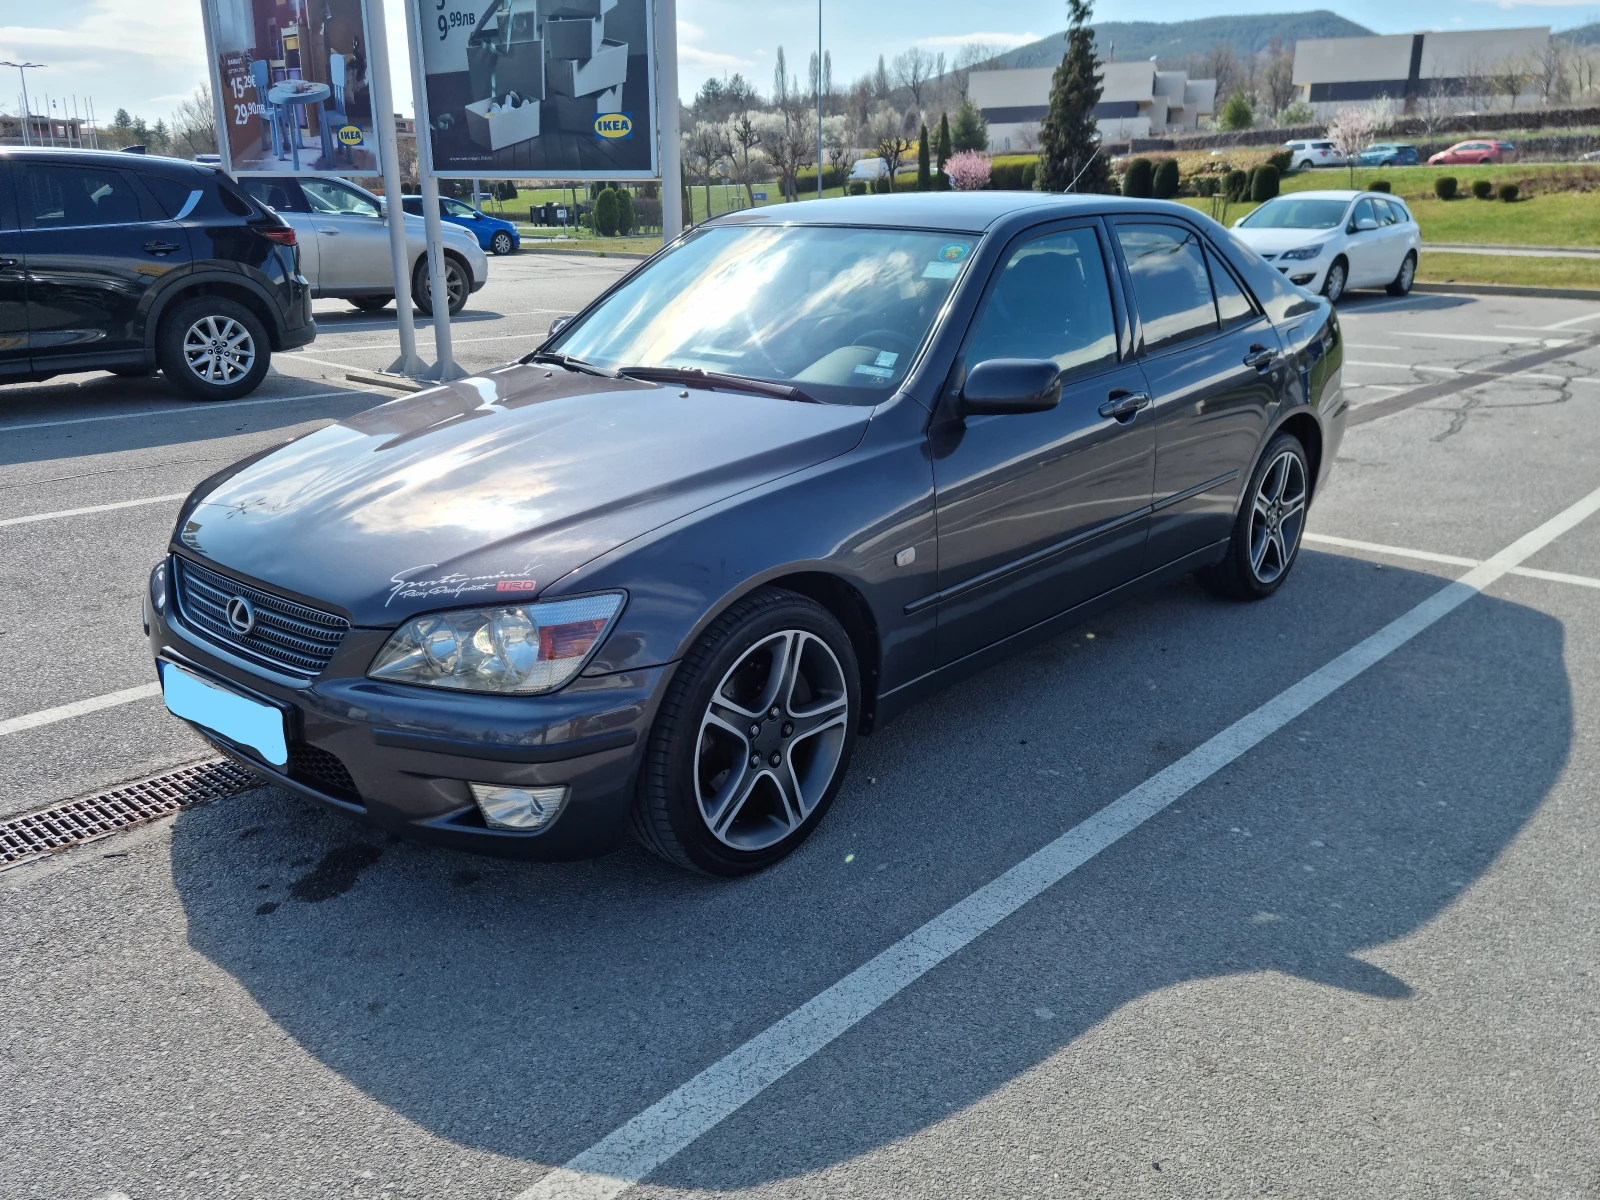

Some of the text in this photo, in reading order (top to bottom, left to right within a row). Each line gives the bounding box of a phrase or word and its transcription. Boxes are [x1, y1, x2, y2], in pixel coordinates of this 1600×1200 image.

[597, 119, 630, 132] IKEA
[340, 130, 362, 140] IKEA
[500, 580, 535, 591] TRD
